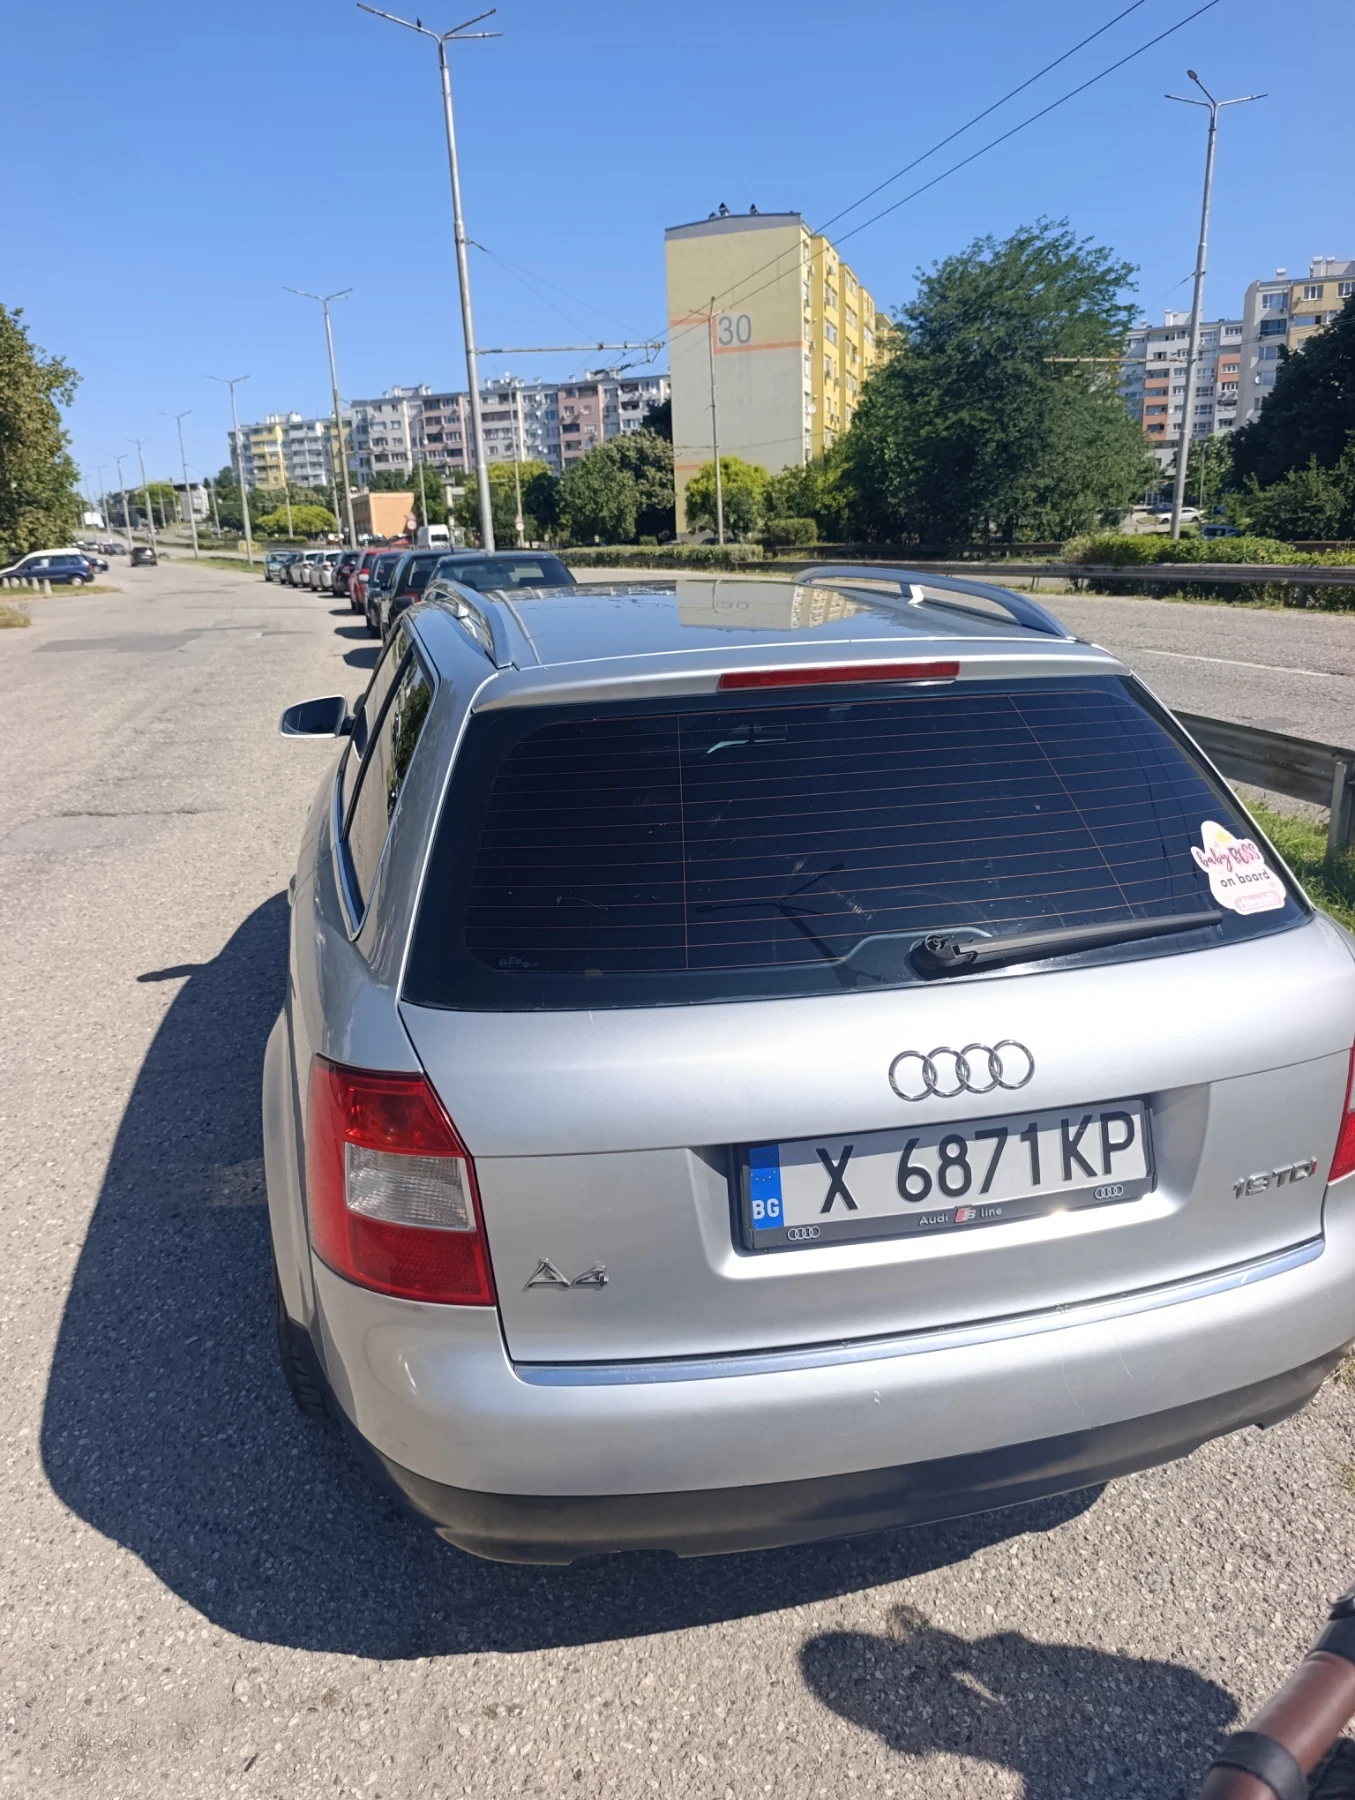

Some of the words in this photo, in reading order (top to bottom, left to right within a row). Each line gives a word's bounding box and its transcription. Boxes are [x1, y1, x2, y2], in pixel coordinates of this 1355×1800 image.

[718, 314, 751, 346] 30
[1196, 848, 1232, 872] baby
[1220, 877, 1236, 888] on
[1235, 869, 1270, 884] board
[752, 1200, 780, 1220] BG
[919, 1213, 949, 1226] Audi
[981, 1207, 1003, 1219] line
[523, 1258, 609, 1289] A4
